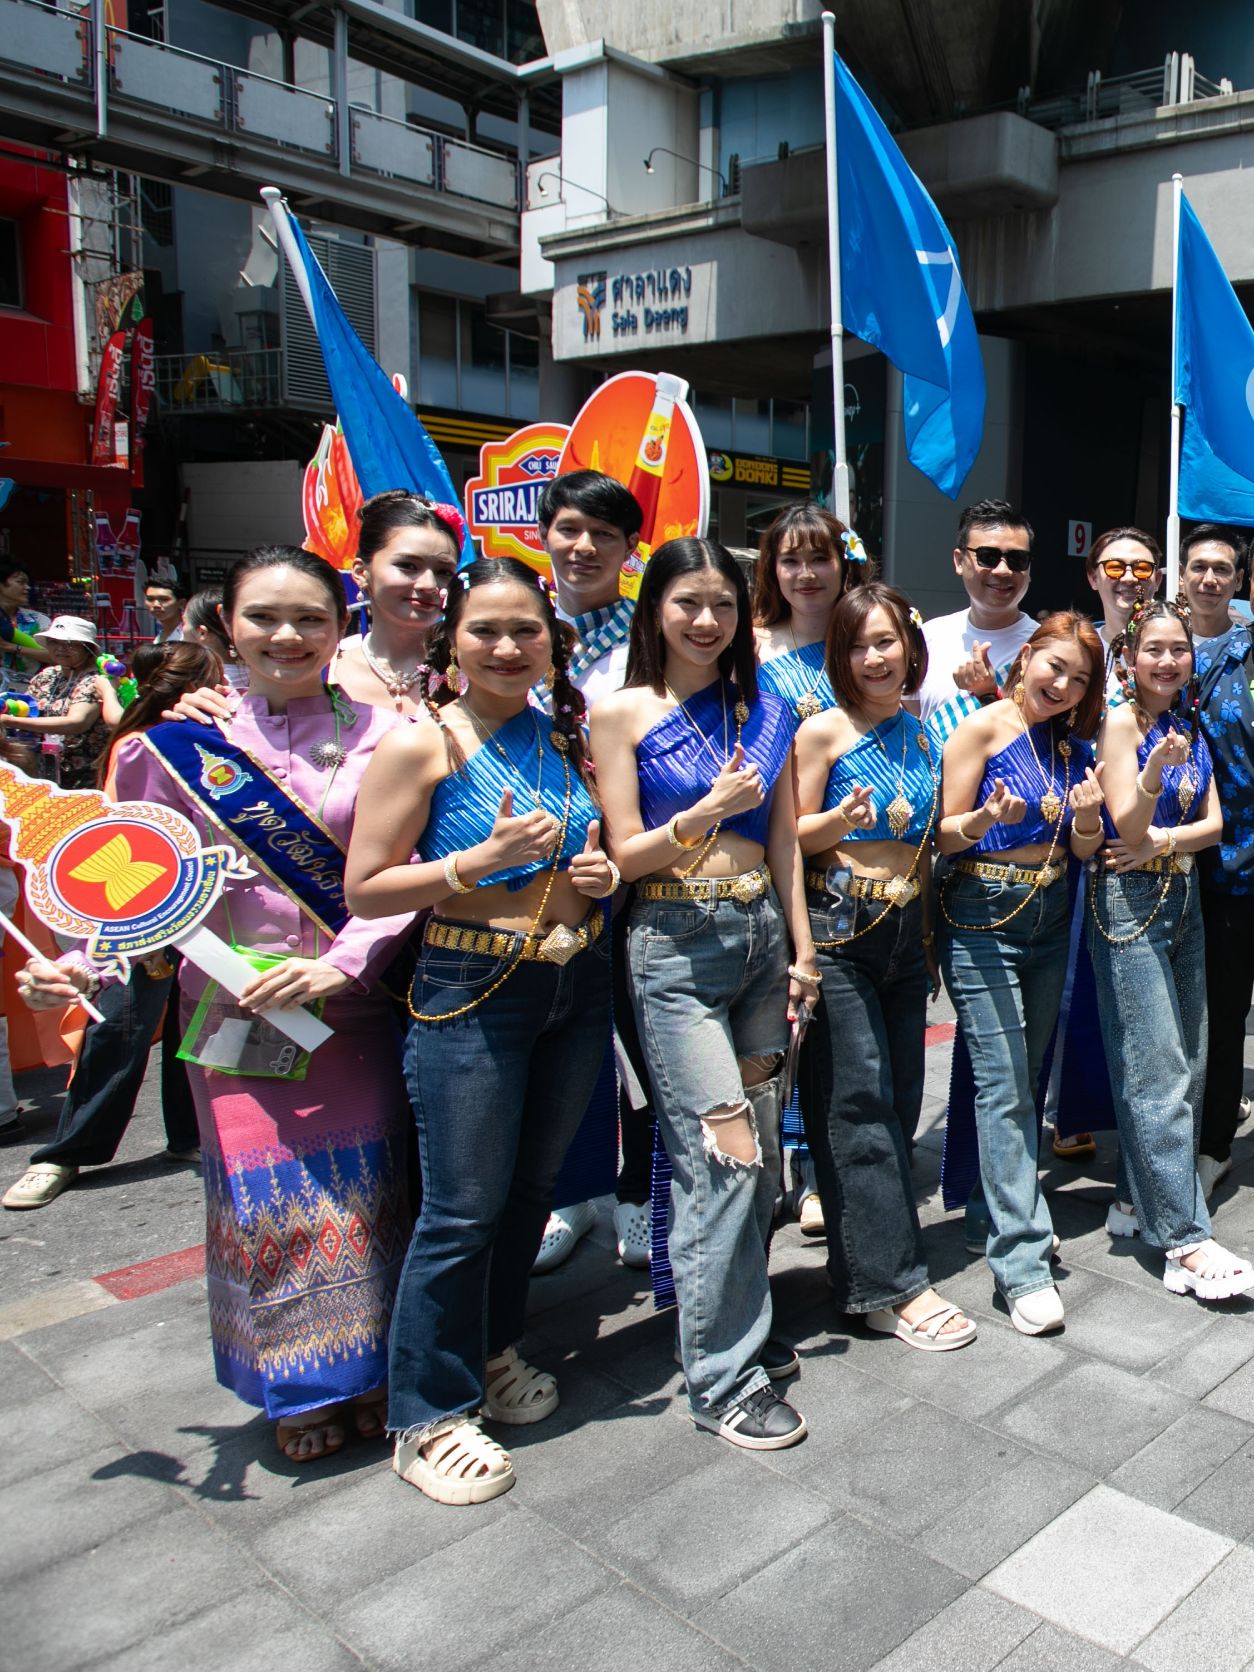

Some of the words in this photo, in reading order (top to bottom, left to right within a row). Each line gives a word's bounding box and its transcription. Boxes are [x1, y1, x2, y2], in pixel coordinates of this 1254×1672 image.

[611, 265, 692, 304] ศาลาแดง
[611, 309, 638, 333] Sala
[643, 305, 689, 331] Daeng
[1074, 522, 1086, 555] 9
[103, 925, 131, 933] ASEAN
[131, 915, 158, 930] Cultural
[185, 860, 195, 882] Council
